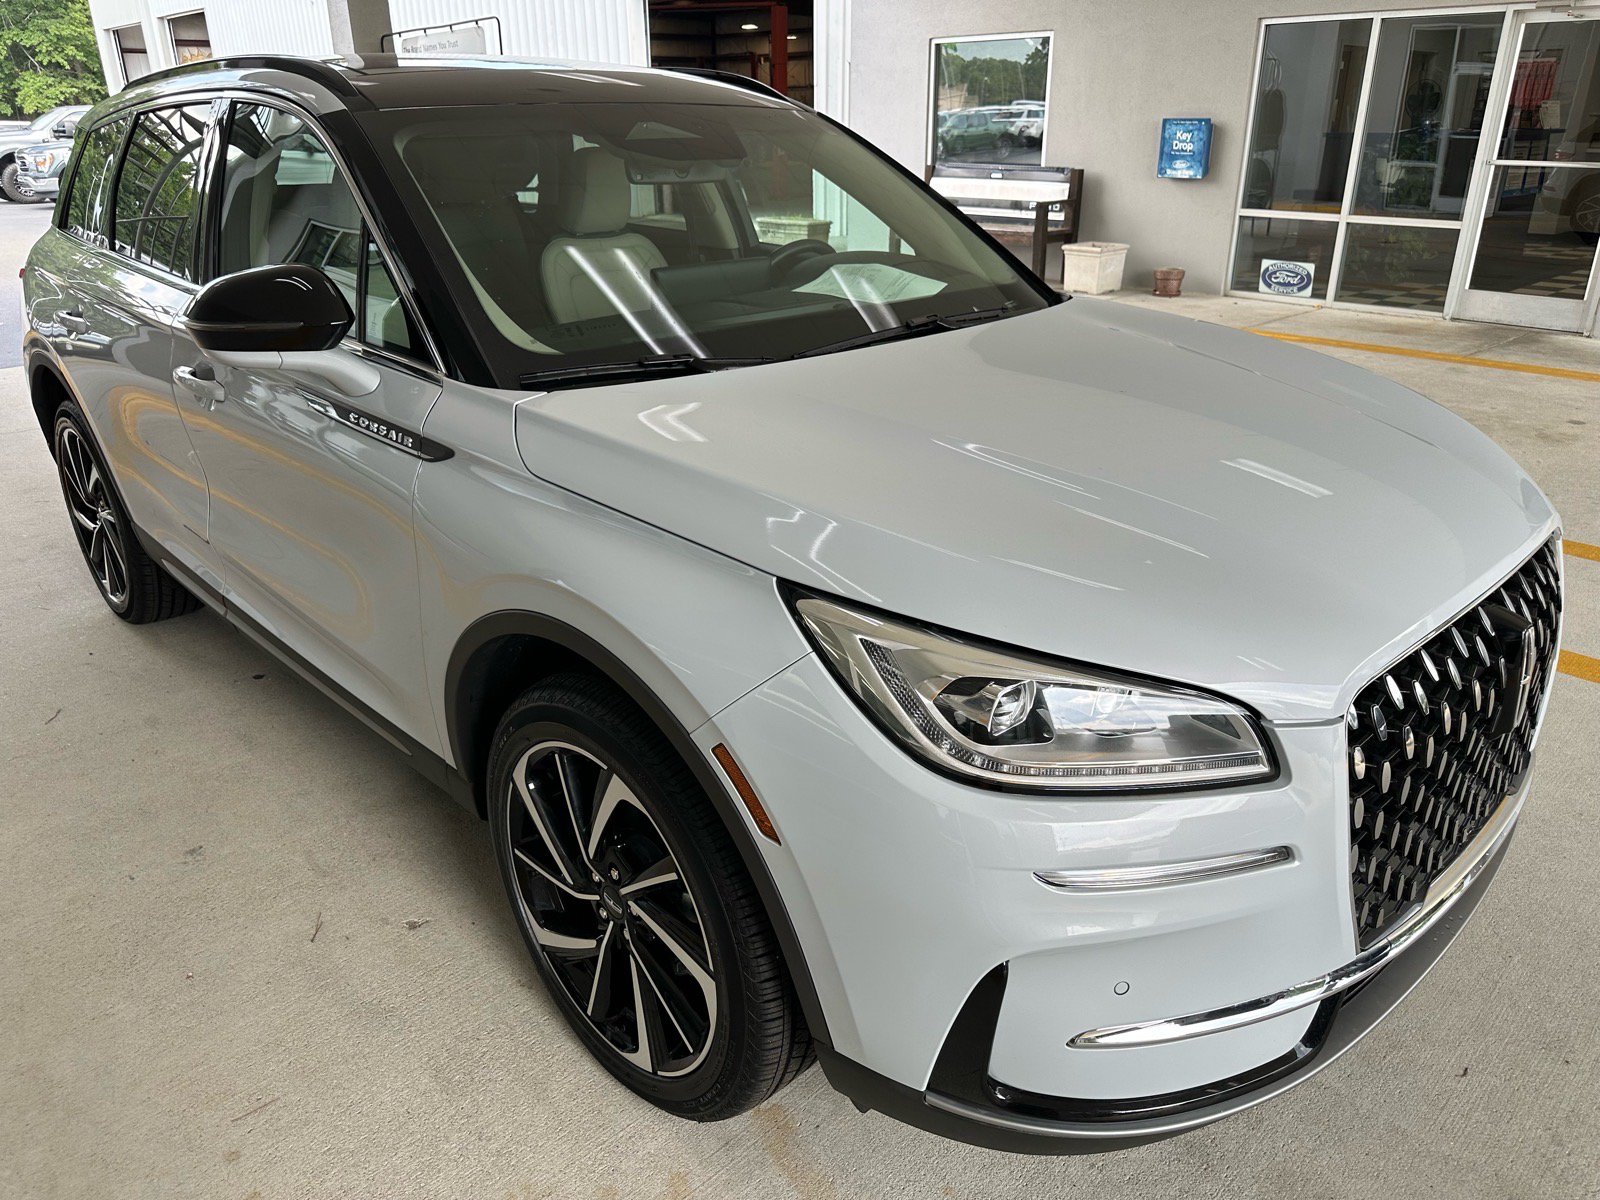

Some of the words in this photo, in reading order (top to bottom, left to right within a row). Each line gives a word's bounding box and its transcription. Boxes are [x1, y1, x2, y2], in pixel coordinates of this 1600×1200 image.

[438, 41, 447, 50] You
[447, 40, 459, 48] Trust
[1176, 130, 1192, 142] Key
[1172, 141, 1194, 152] Drop
[1268, 262, 1308, 276] AUTHORIZED
[1271, 270, 1301, 284] Ford
[1270, 285, 1299, 295] SERVICE
[349, 412, 413, 448] CORSAIR
